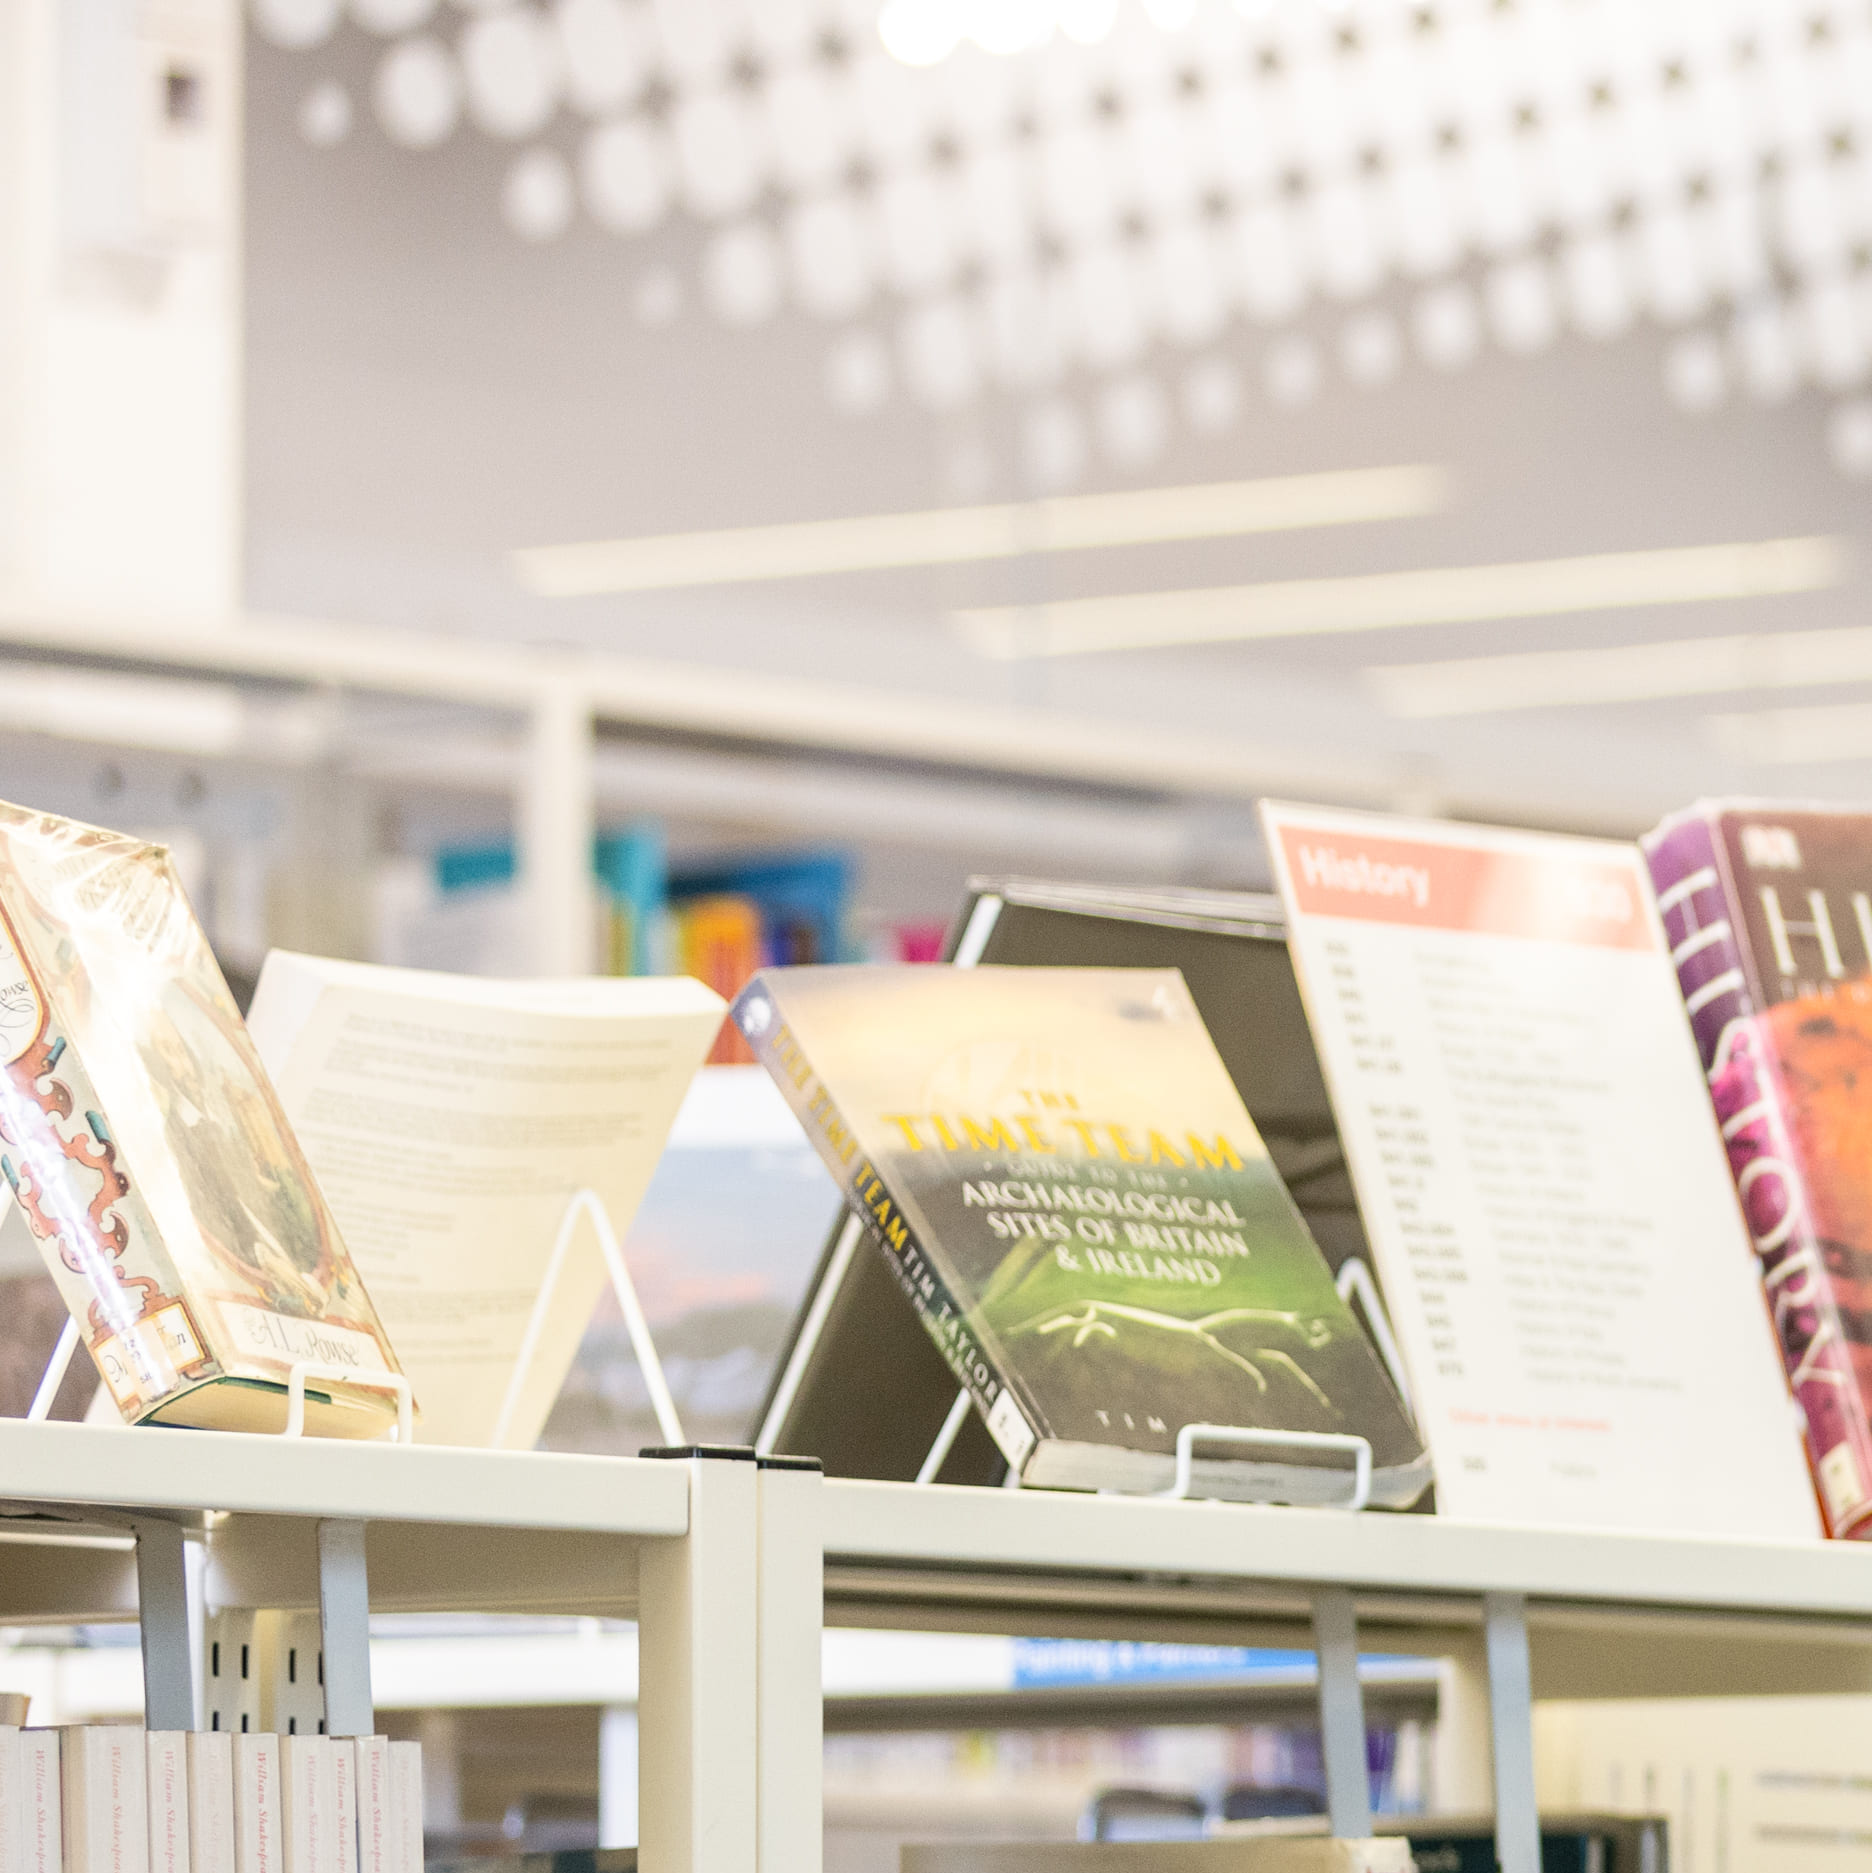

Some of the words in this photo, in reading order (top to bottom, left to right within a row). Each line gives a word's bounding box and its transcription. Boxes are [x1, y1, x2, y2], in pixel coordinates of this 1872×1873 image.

[1299, 845, 1430, 906] History
[881, 1112, 1058, 1155] TIME
[1061, 1117, 1245, 1172] TEAM
[1657, 866, 1846, 1386] HISTORY
[961, 1180, 1247, 1229] ARCHAEOLOGICAL
[986, 1210, 1073, 1241] SITES
[1075, 1215, 1117, 1247] OF
[1122, 1221, 1250, 1258] BRITAIN
[1055, 1243, 1083, 1272] &
[1086, 1246, 1222, 1288] IRELAND
[257, 1751, 268, 1805] William
